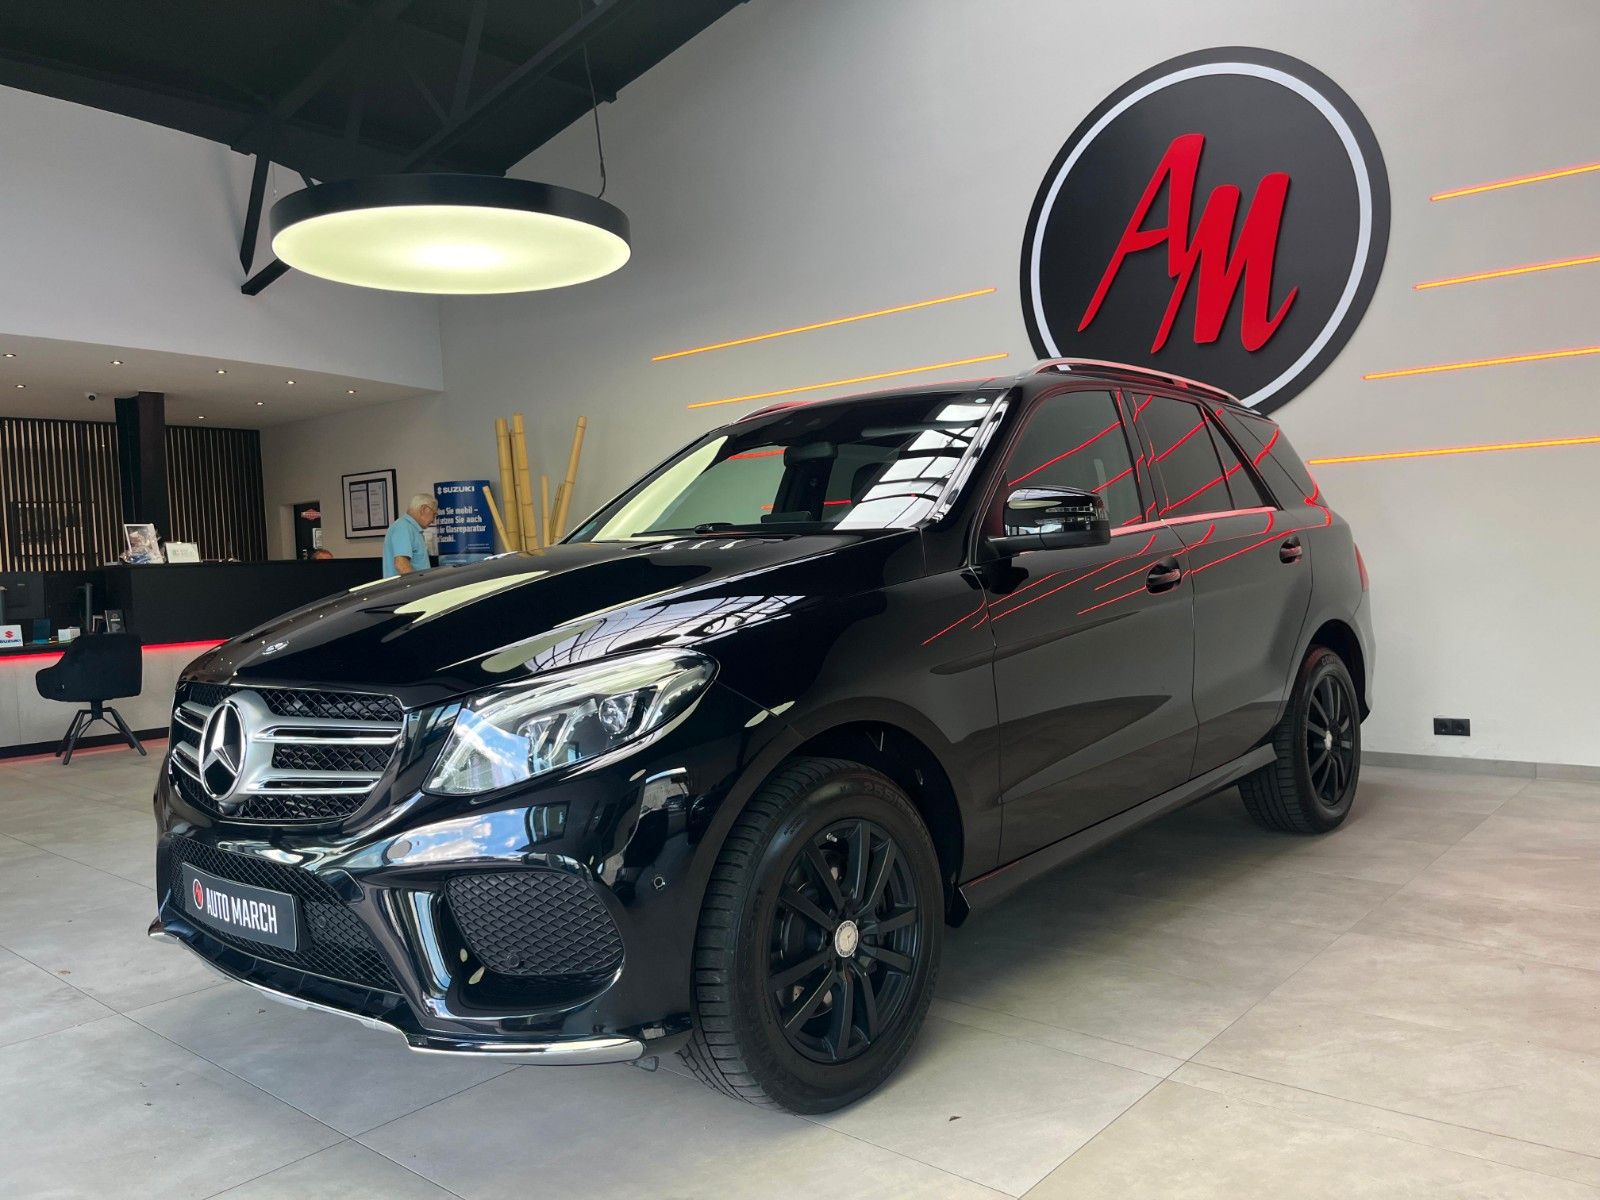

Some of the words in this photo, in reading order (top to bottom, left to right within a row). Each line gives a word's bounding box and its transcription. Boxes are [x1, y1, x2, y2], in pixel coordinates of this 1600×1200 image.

[1077, 133, 1299, 354] AM
[455, 516, 465, 524] Sie
[467, 515, 482, 523] auch
[206, 888, 230, 922] AUTO
[231, 897, 278, 934] MARCH
